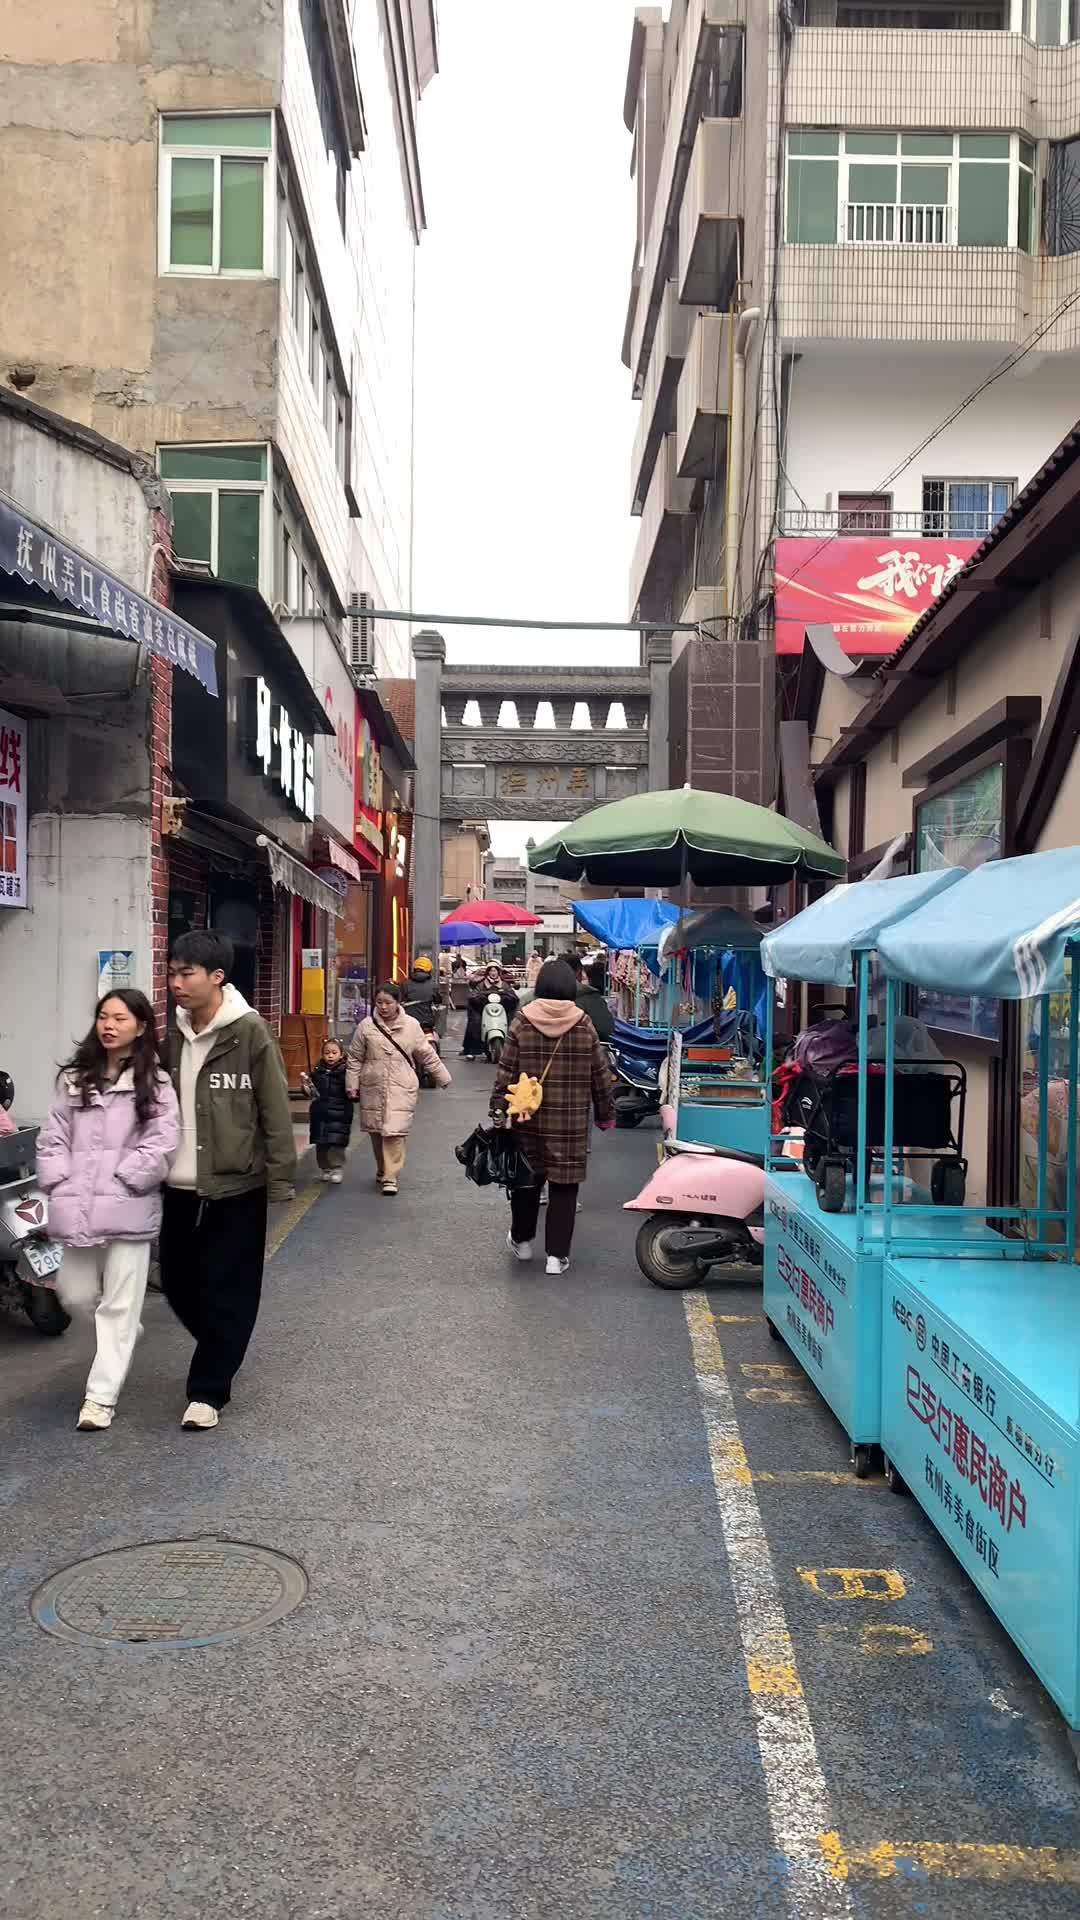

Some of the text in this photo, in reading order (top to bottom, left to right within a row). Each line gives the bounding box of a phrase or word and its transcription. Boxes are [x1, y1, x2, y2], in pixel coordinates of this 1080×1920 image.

[209, 1073, 253, 1090] SNA
[931, 1332, 997, 1417] 中国工商银行
[924, 1453, 1000, 1579] 抚州弄美食街区
